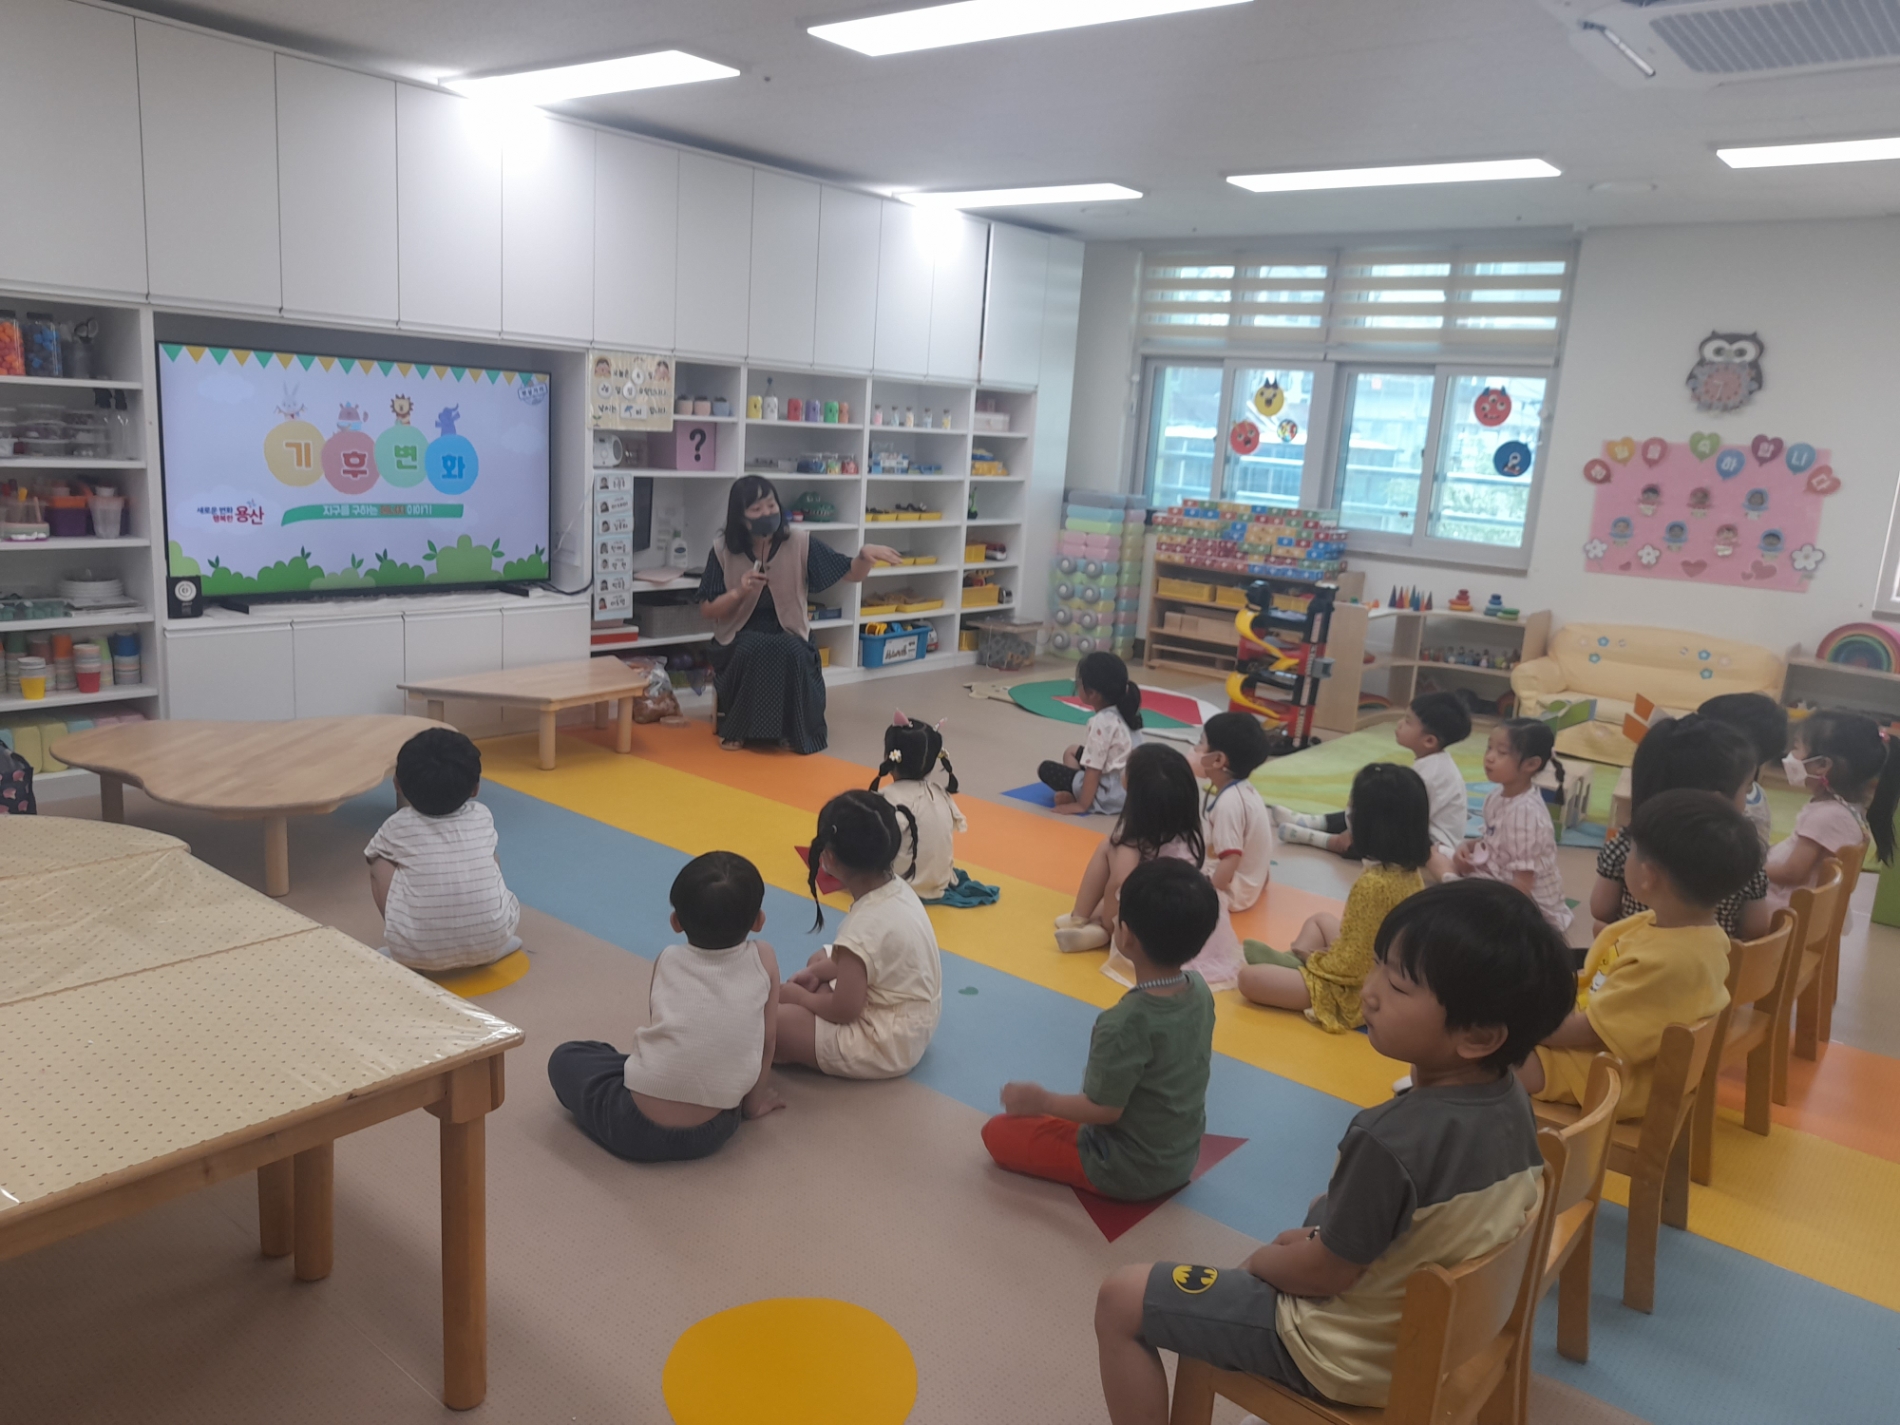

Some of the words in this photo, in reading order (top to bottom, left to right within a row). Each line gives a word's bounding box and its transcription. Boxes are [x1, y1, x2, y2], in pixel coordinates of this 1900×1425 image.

[283, 440, 466, 480] 기후변화
[197, 506, 218, 514] 새로운
[234, 505, 265, 525] 용산
[322, 504, 350, 516] 지구를
[352, 504, 379, 516] 구하는
[406, 504, 433, 516] 이야기
